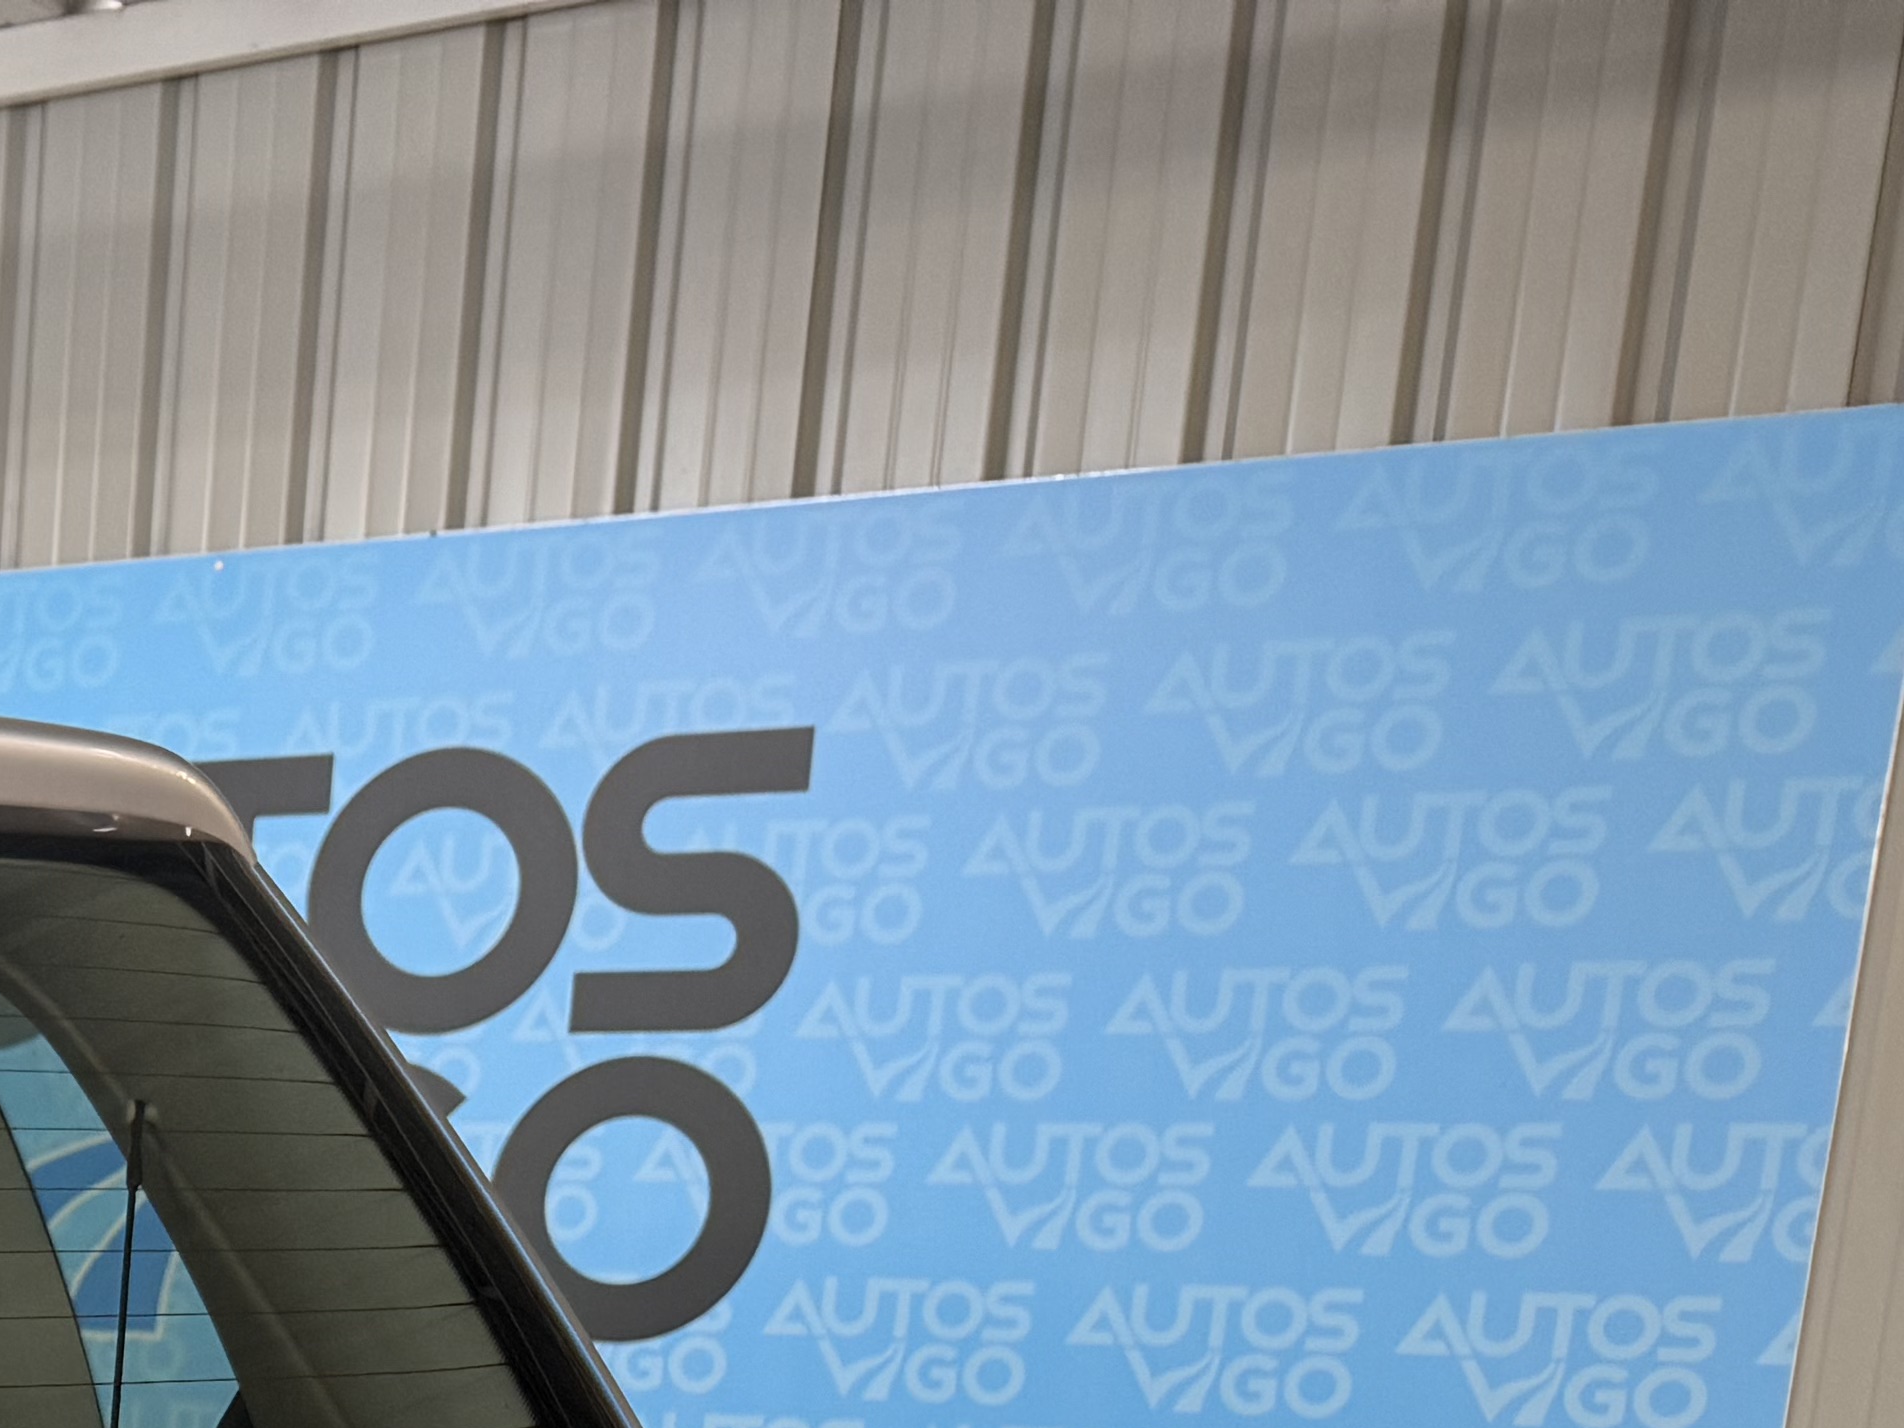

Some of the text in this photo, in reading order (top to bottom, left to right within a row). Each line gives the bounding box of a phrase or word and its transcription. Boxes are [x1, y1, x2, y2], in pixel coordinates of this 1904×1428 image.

[1000, 467, 1295, 557] AUTOS
[1334, 440, 1665, 532] AUTOS
[413, 523, 663, 604] AUTOS
[694, 502, 964, 582] AUTOS
[1399, 513, 1652, 593] VIGO
[154, 552, 380, 624] AUTOS
[747, 567, 957, 638] VIGO
[1056, 541, 1287, 616] VIGO
[197, 612, 376, 679] VIGO
[459, 592, 657, 660] VIGO
[1487, 607, 1833, 695] AUTOS
[824, 651, 1111, 732] AUTOS
[1143, 630, 1456, 714] AUTOS
[539, 672, 796, 748] AUTOS
[1207, 704, 1443, 778] VIGO
[1558, 685, 1818, 761] VIGO
[885, 724, 1099, 791] VIGO
[961, 801, 1258, 877] AUTOS
[1290, 785, 1614, 863] AUTOS
[1022, 868, 1246, 939] VIGO
[1352, 859, 1600, 932] VIGO
[794, 971, 1072, 1038] AUTOS
[1104, 963, 1410, 1034] AUTOS
[1441, 957, 1776, 1031] AUTOS
[852, 1037, 1063, 1102] VIGO
[1163, 1035, 1396, 1101] VIGO
[1507, 1031, 1762, 1100] VIGO
[925, 1121, 1216, 1185] AUTOS
[1246, 1120, 1564, 1188] AUTOS
[986, 1188, 1203, 1252] VIGO
[1309, 1190, 1551, 1259] VIGO
[763, 1276, 1035, 1337] AUTOS
[1065, 1284, 1364, 1354] AUTOS
[1395, 1290, 1722, 1364] AUTOS
[818, 1336, 1025, 1406] VIGO
[1123, 1348, 1352, 1419] VIGO
